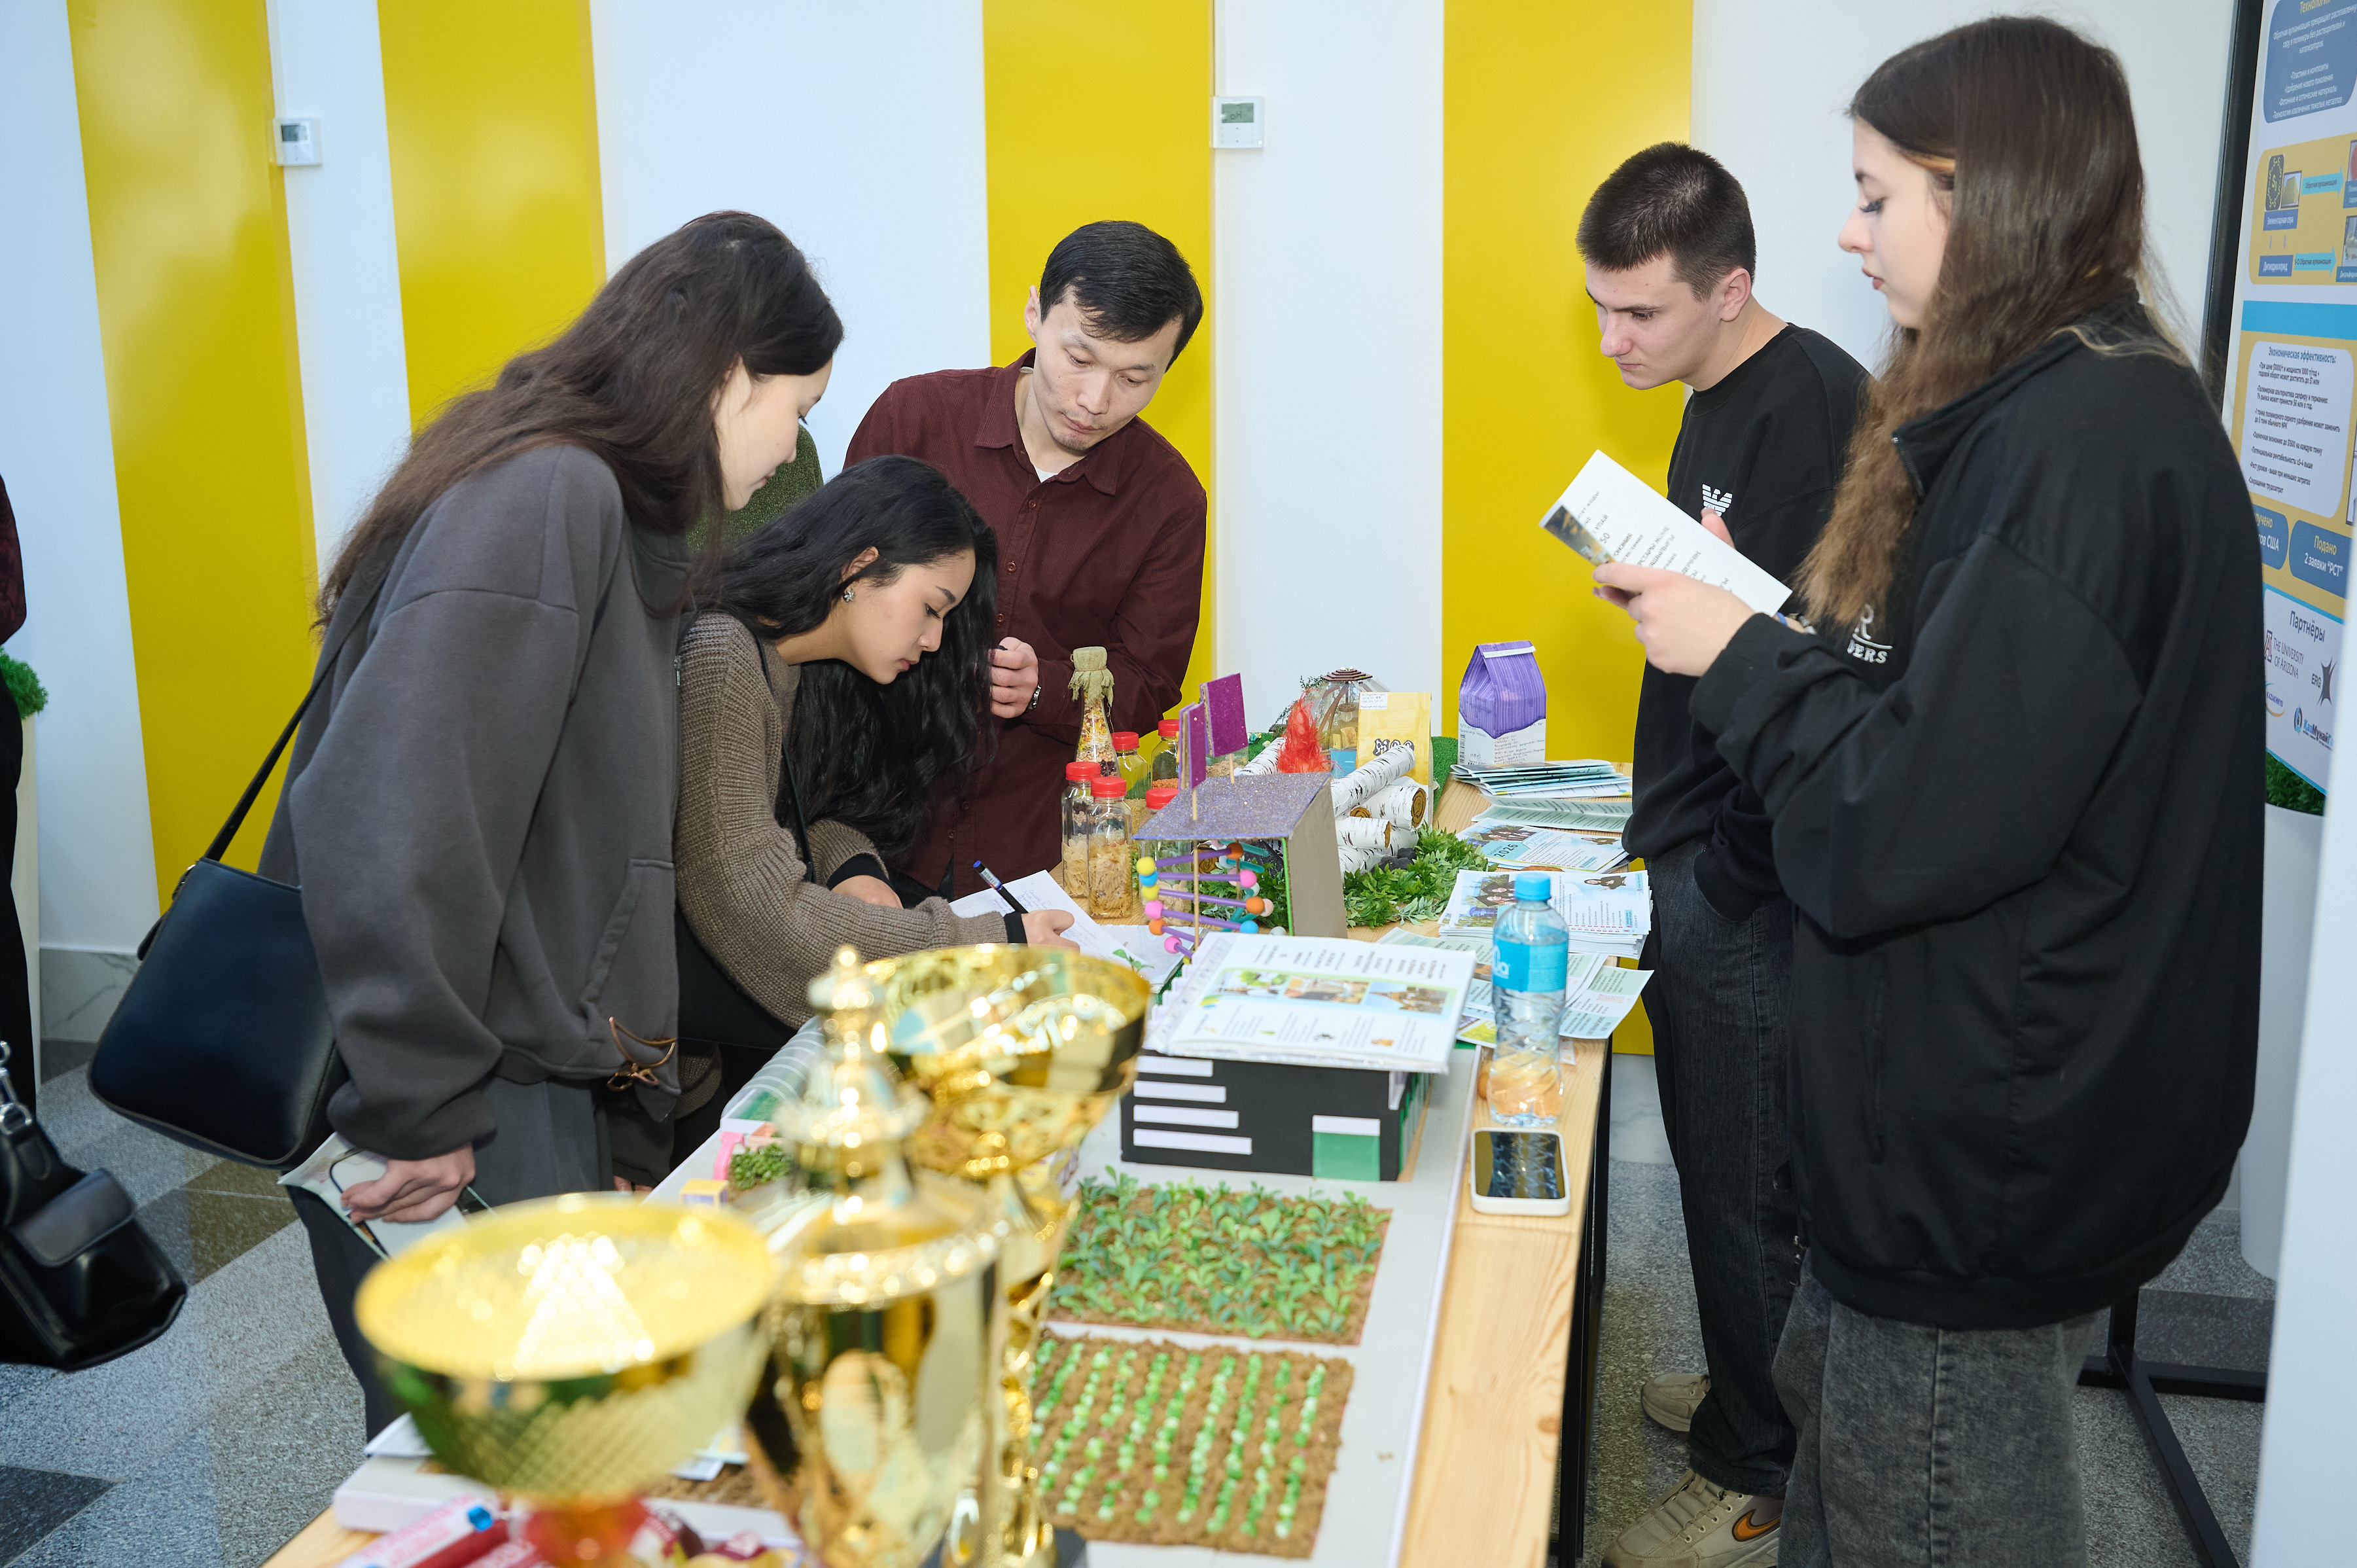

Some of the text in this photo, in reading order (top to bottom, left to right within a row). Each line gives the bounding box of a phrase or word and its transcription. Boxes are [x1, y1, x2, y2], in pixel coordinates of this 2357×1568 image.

[2269, 347, 2336, 364] Экономическая эффективность:
[2267, 535, 2279, 551] США
[2314, 535, 2337, 555] Подано
[2304, 552, 2309, 564] 2
[2309, 556, 2326, 572] заявки
[2290, 610, 2325, 642] Партнёры
[2275, 656, 2280, 667] OF
[2281, 643, 2304, 665] UNIVERSITY
[2311, 673, 2321, 688] ERG
[1493, 844, 1518, 857] 2026
